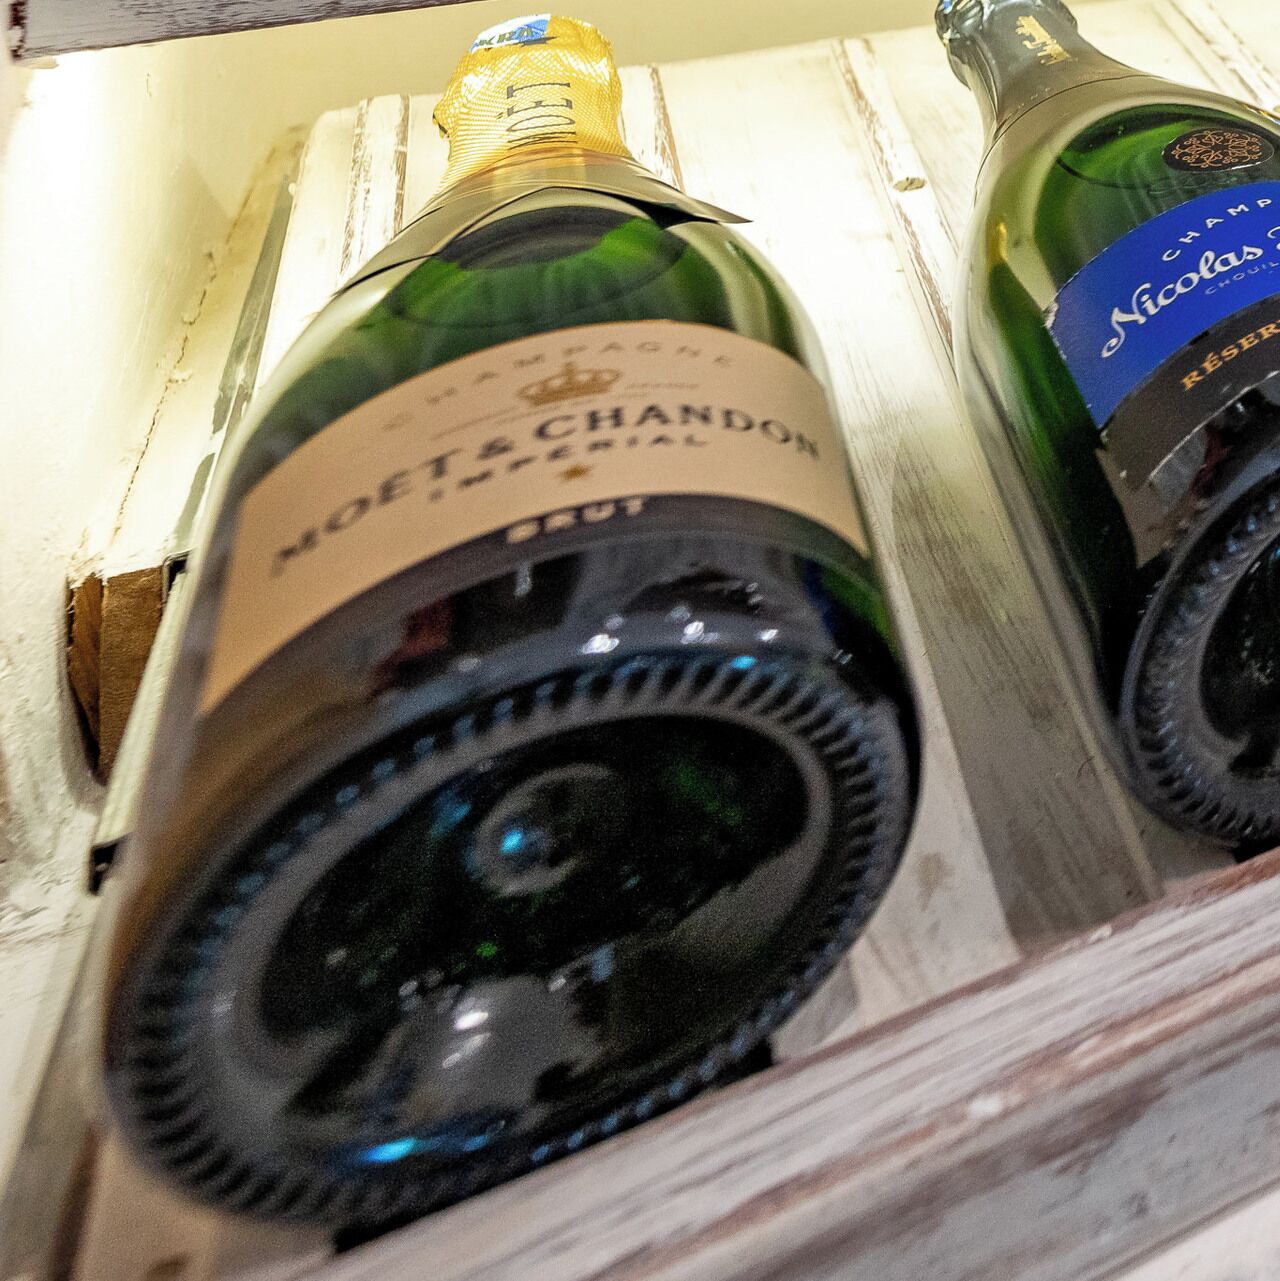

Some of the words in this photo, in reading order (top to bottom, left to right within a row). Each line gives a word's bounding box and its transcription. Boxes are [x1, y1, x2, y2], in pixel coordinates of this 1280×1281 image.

[1101, 243, 1265, 359] Nicolas
[475, 434, 516, 461] &
[533, 403, 821, 461] CHANDON
[505, 495, 648, 545] BRUT
